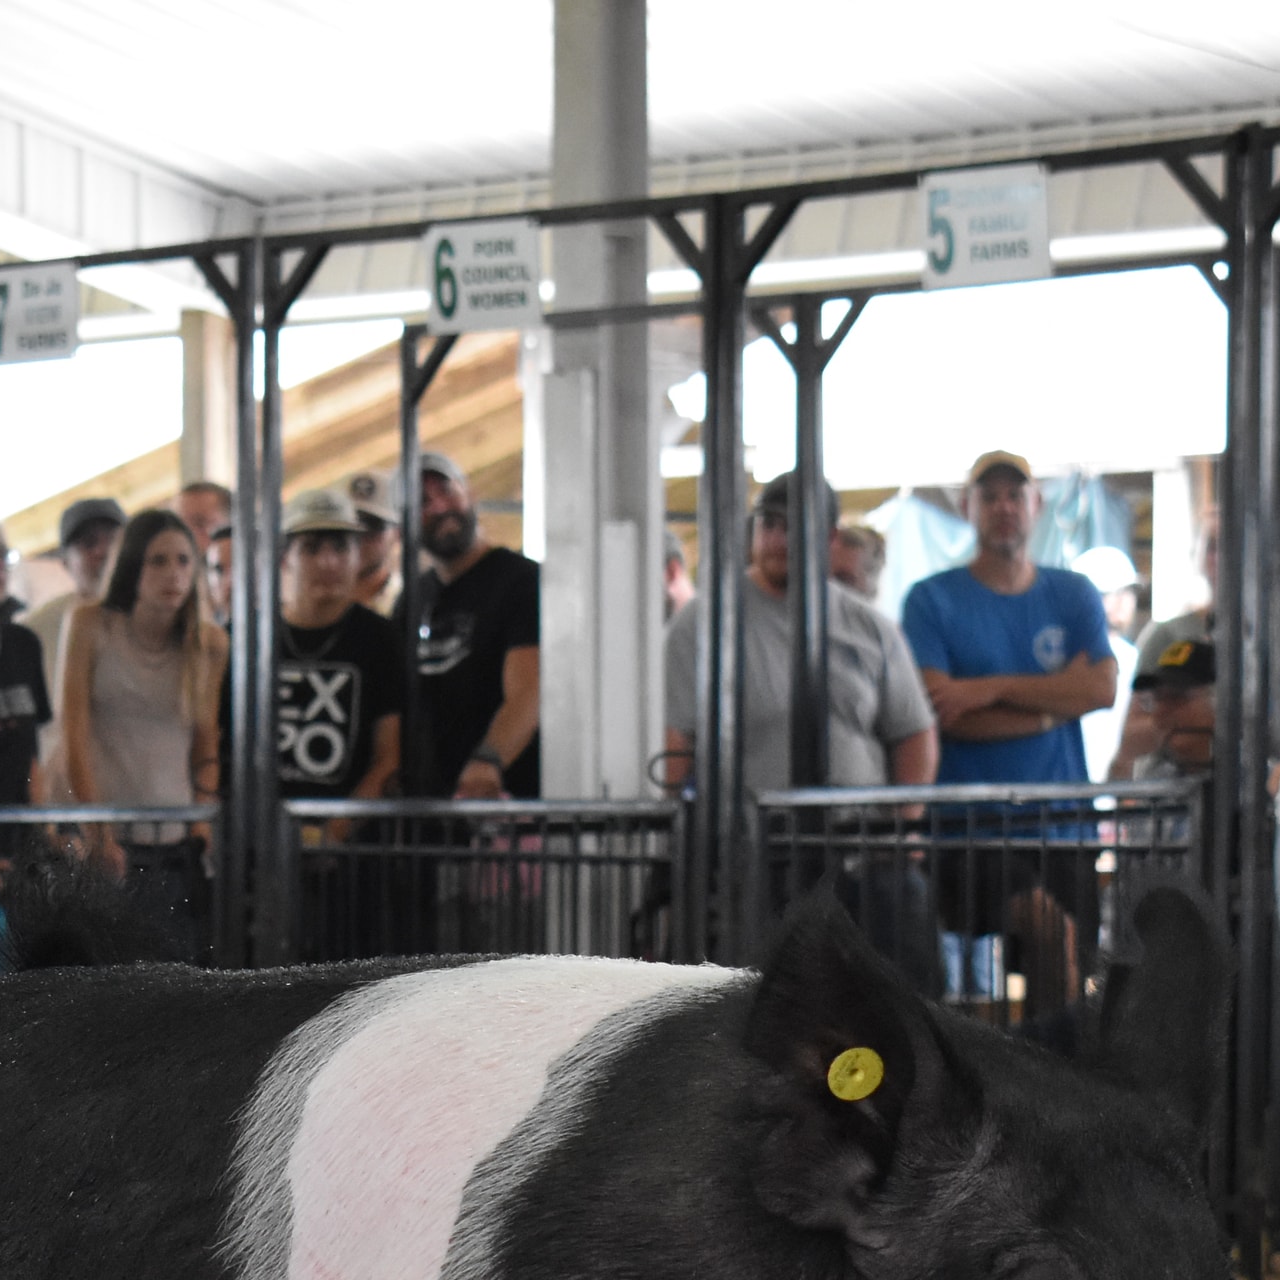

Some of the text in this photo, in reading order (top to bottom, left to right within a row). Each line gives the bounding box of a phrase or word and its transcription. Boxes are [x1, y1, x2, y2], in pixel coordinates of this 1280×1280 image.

[927, 188, 955, 276] 5
[472, 238, 516, 257] PORK
[970, 239, 1030, 264] FARMS
[434, 236, 459, 320] 6
[461, 264, 531, 286] COUNCIL
[468, 290, 527, 311] WOMEN
